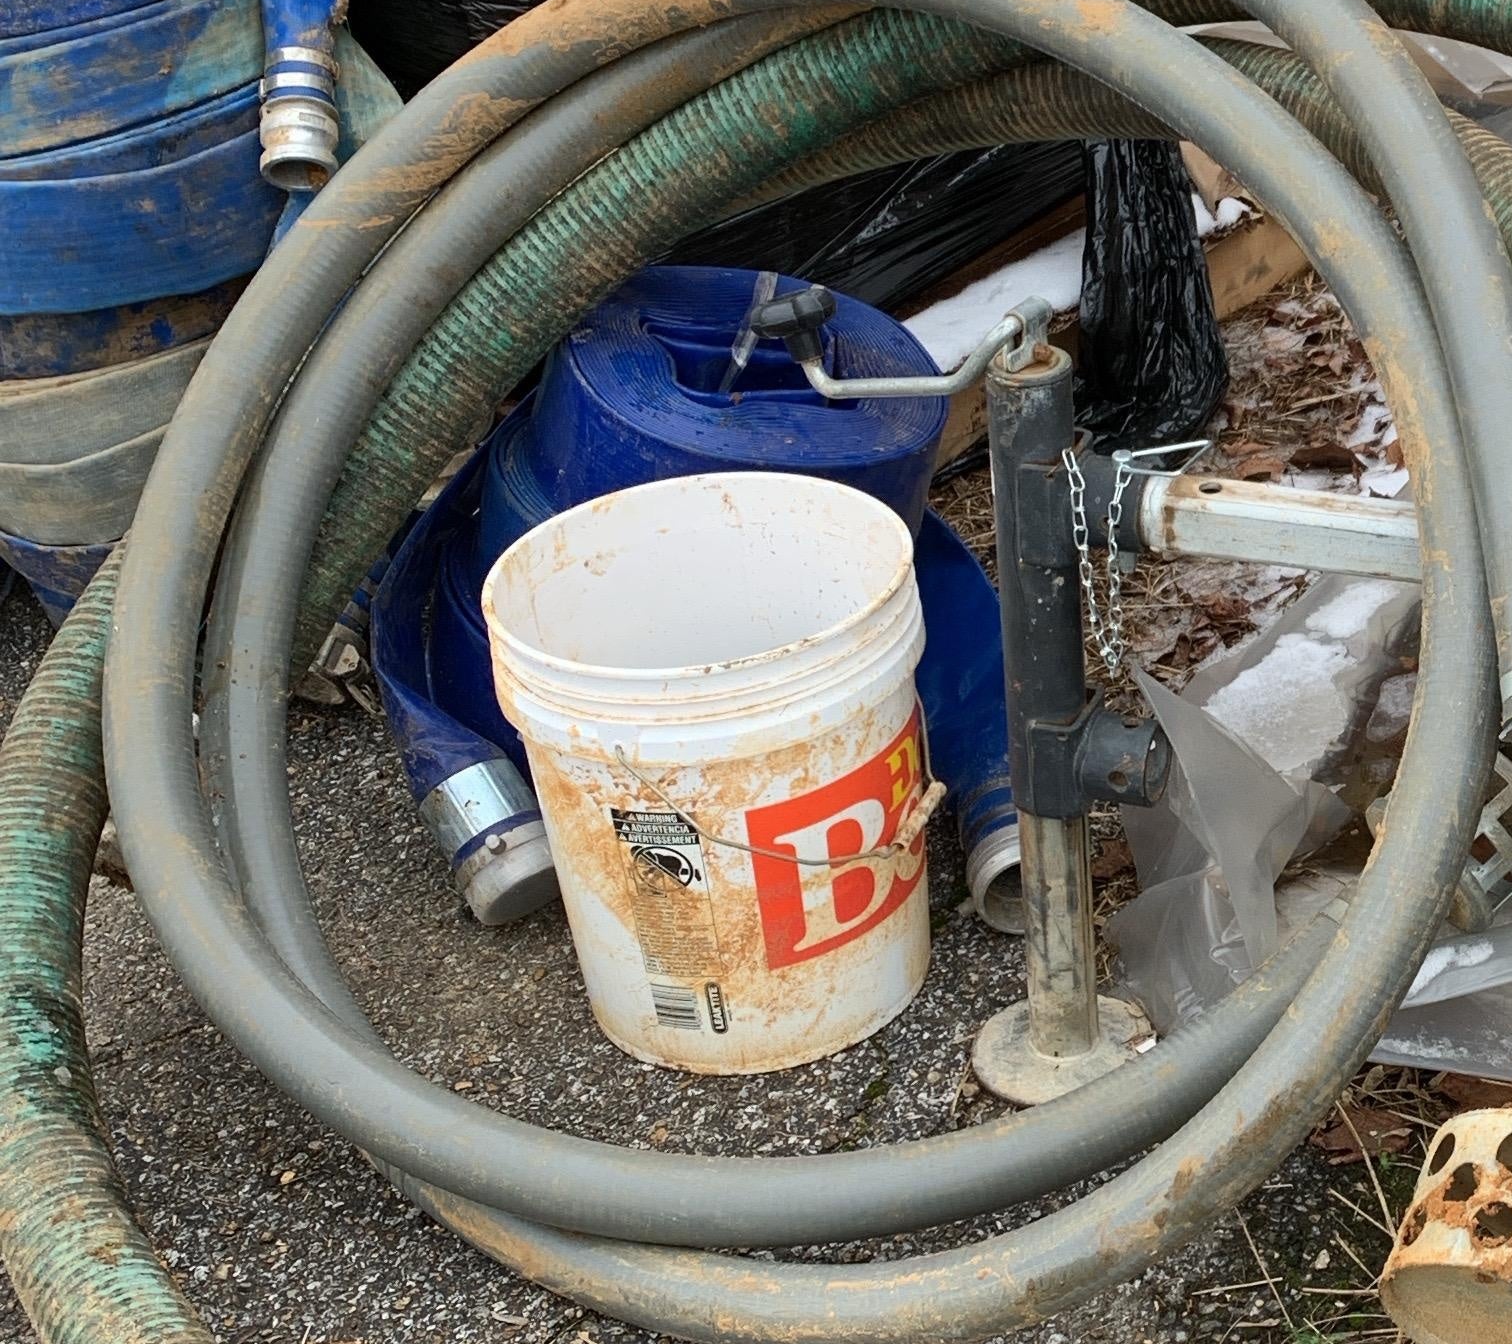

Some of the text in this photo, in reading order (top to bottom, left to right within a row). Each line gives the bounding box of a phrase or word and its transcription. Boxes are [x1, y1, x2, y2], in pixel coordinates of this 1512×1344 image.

[636, 813, 678, 823] WARNING
[631, 824, 690, 834] ADVERTENCIA
[628, 833, 697, 844] AVERTISSEMENT
[709, 986, 725, 1030] LEAKTITE
